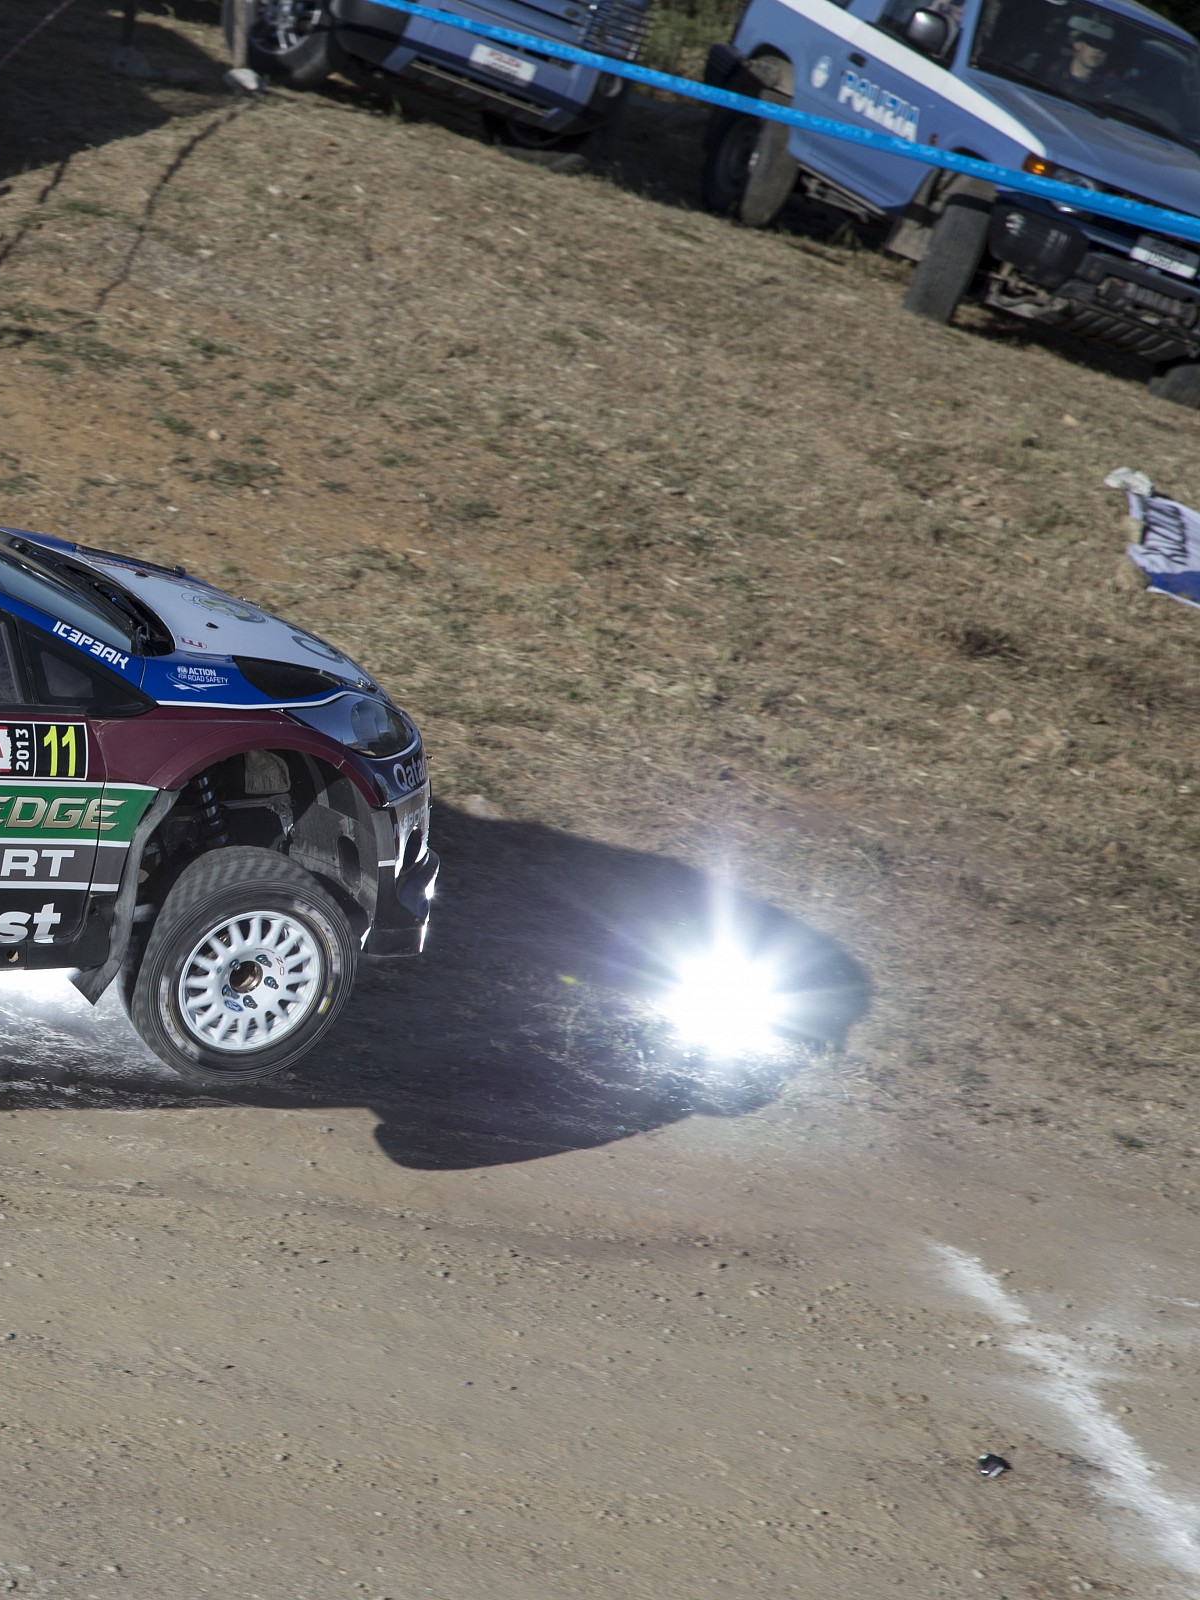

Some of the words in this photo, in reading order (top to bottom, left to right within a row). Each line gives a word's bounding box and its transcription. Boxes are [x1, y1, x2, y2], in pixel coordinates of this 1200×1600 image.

[837, 70, 920, 143] POLIZIA
[187, 674, 205, 682] ROAD
[205, 676, 229, 684] SAFETY
[188, 667, 217, 677] ACTION
[15, 728, 30, 771] 2013
[43, 725, 77, 777] 11
